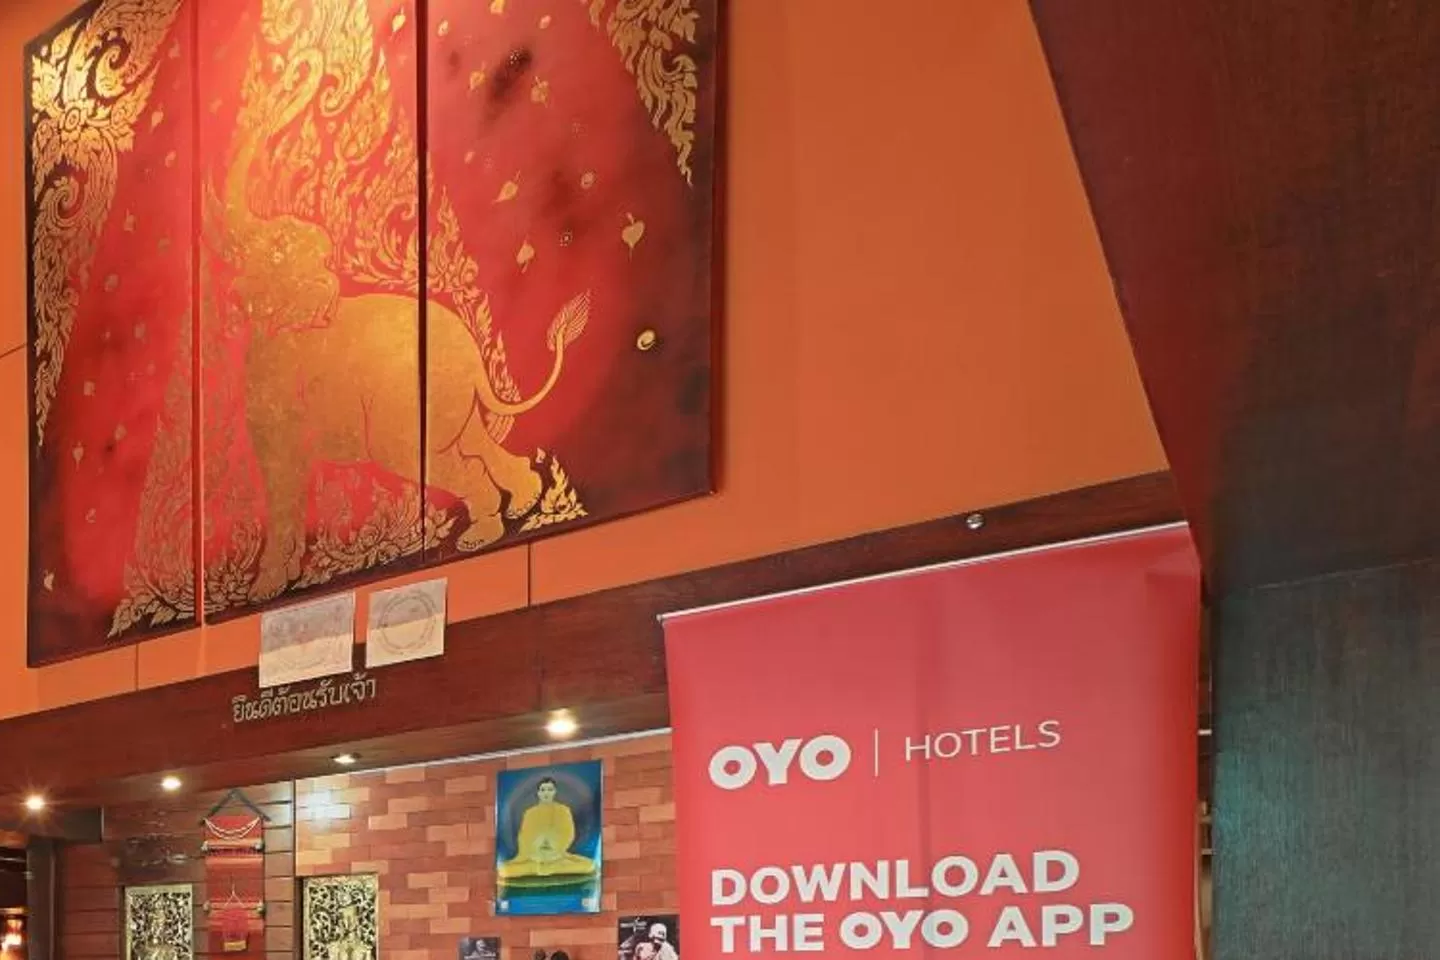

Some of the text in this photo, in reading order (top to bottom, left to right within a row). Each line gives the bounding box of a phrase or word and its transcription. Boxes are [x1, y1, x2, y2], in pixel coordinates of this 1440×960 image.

[708, 720, 1061, 790] OYO HOTELS
[711, 850, 1079, 906] DOWNLOAD
[710, 903, 1134, 952] THE OYO APP
